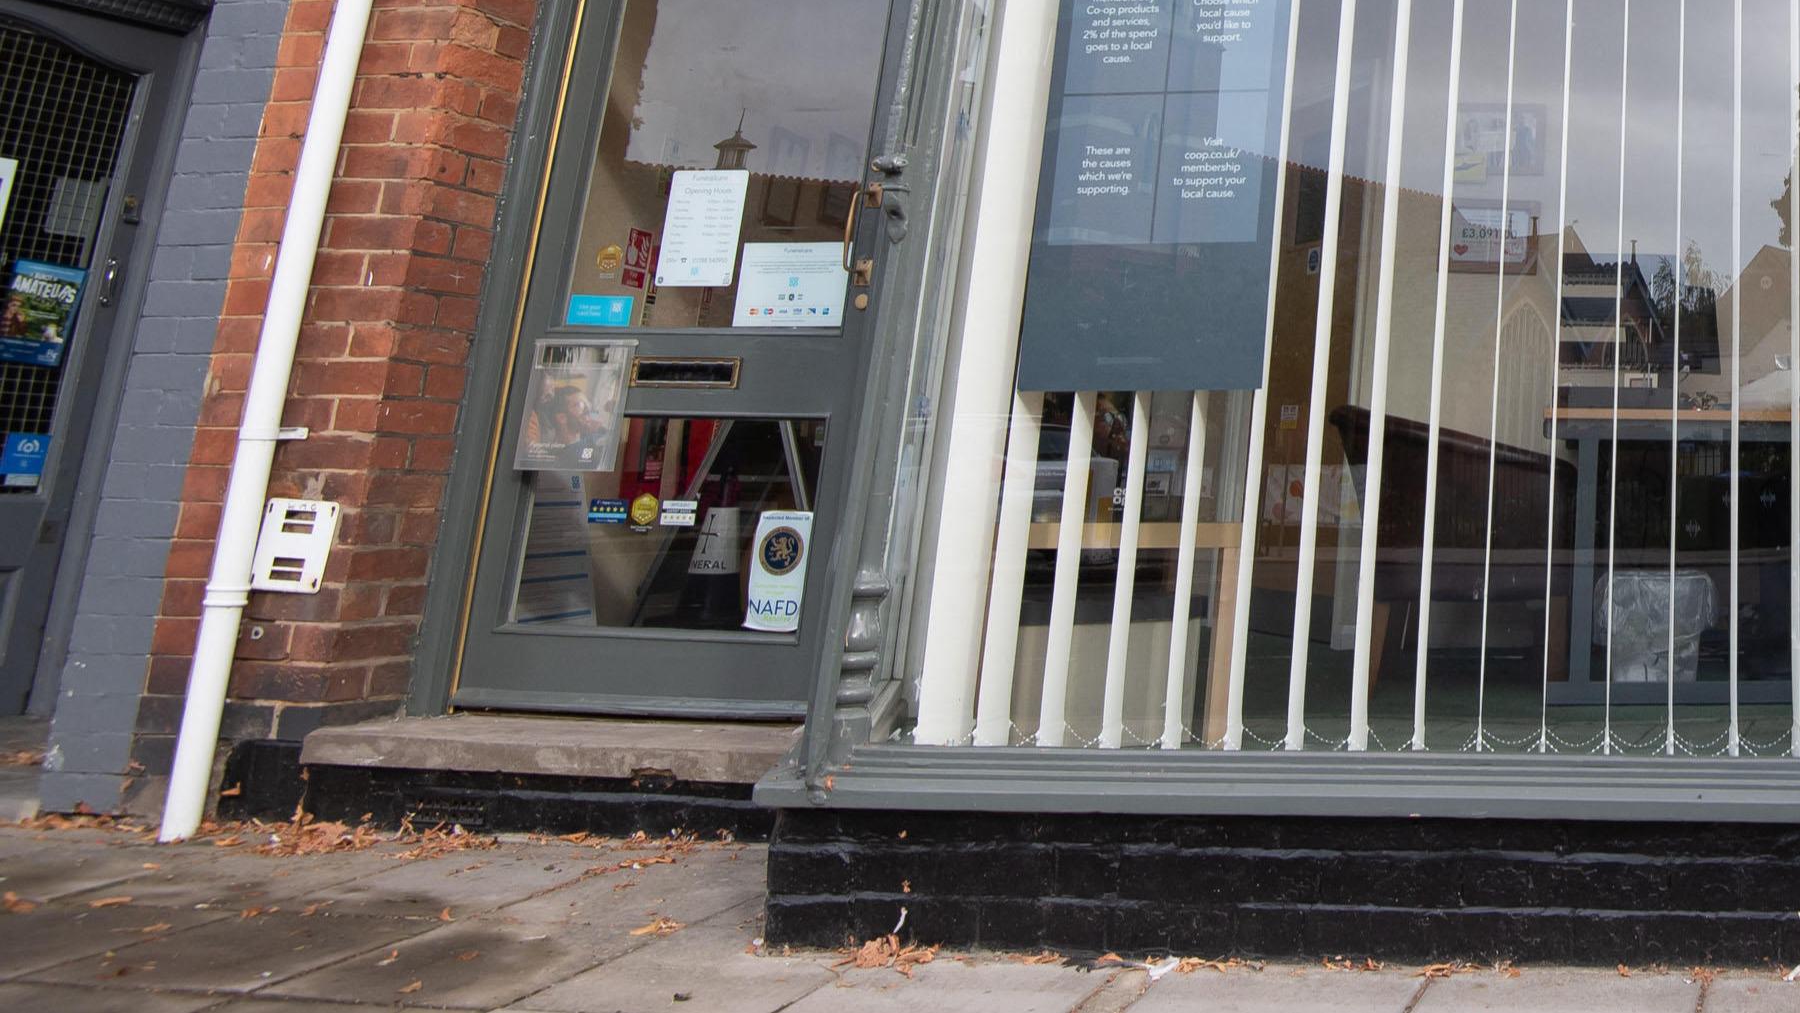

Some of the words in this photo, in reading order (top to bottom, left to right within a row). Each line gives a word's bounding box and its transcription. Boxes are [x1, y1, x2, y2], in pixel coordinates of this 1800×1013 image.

[1087, 6, 1116, 16] Co-op
[1118, 6, 1159, 16] products
[1200, 8, 1221, 17] local
[1092, 18, 1110, 26] and
[1224, 20, 1239, 29] like
[1083, 30, 1097, 39] 2%
[1100, 30, 1110, 38] of
[1112, 30, 1126, 38] the
[1128, 29, 1157, 39] spend
[1203, 33, 1242, 43] support.
[1085, 43, 1108, 53] goes
[1111, 42, 1120, 50] to
[1131, 41, 1152, 49] local
[1204, 137, 1223, 146] Visit
[1086, 146, 1113, 155] These
[1082, 159, 1097, 168] the
[1100, 160, 1131, 168] causes
[1181, 162, 1240, 173] membership
[1079, 172, 1105, 181] which
[1174, 177, 1183, 185] to
[1186, 176, 1222, 187] support
[1225, 177, 1246, 187] your
[685, 187, 712, 195] Opening
[1181, 189, 1203, 198] local
[12, 275, 76, 303] AMATEURS
[750, 599, 798, 616] NAFD
